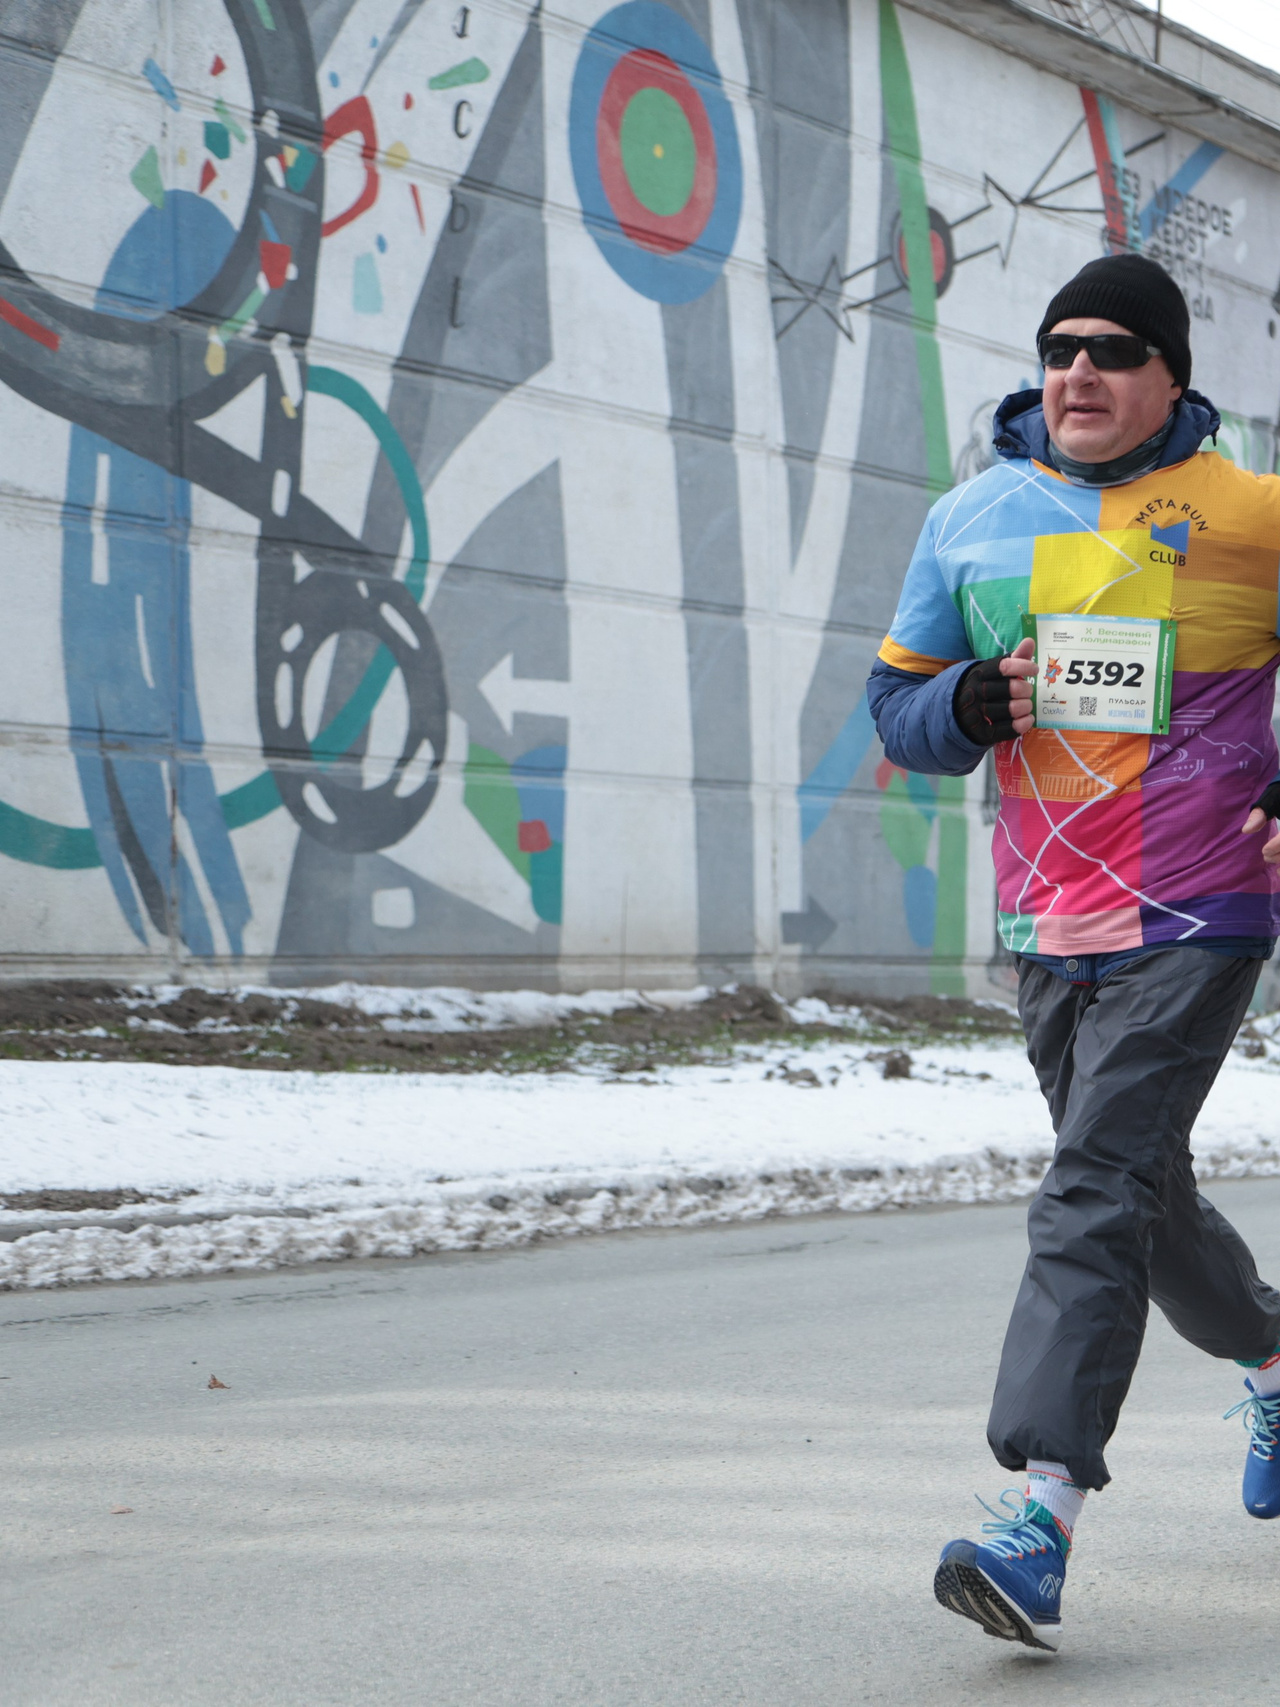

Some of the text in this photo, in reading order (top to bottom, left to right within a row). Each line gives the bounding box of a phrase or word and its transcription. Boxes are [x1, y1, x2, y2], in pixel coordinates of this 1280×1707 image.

[1135, 499, 1208, 532] META RUN
[1149, 550, 1186, 567] CLUB
[1098, 627, 1152, 639] Весенний
[1081, 636, 1151, 647] полумарафон
[1065, 660, 1145, 688] 5392
[1108, 698, 1147, 706] ПУЛЬСАР
